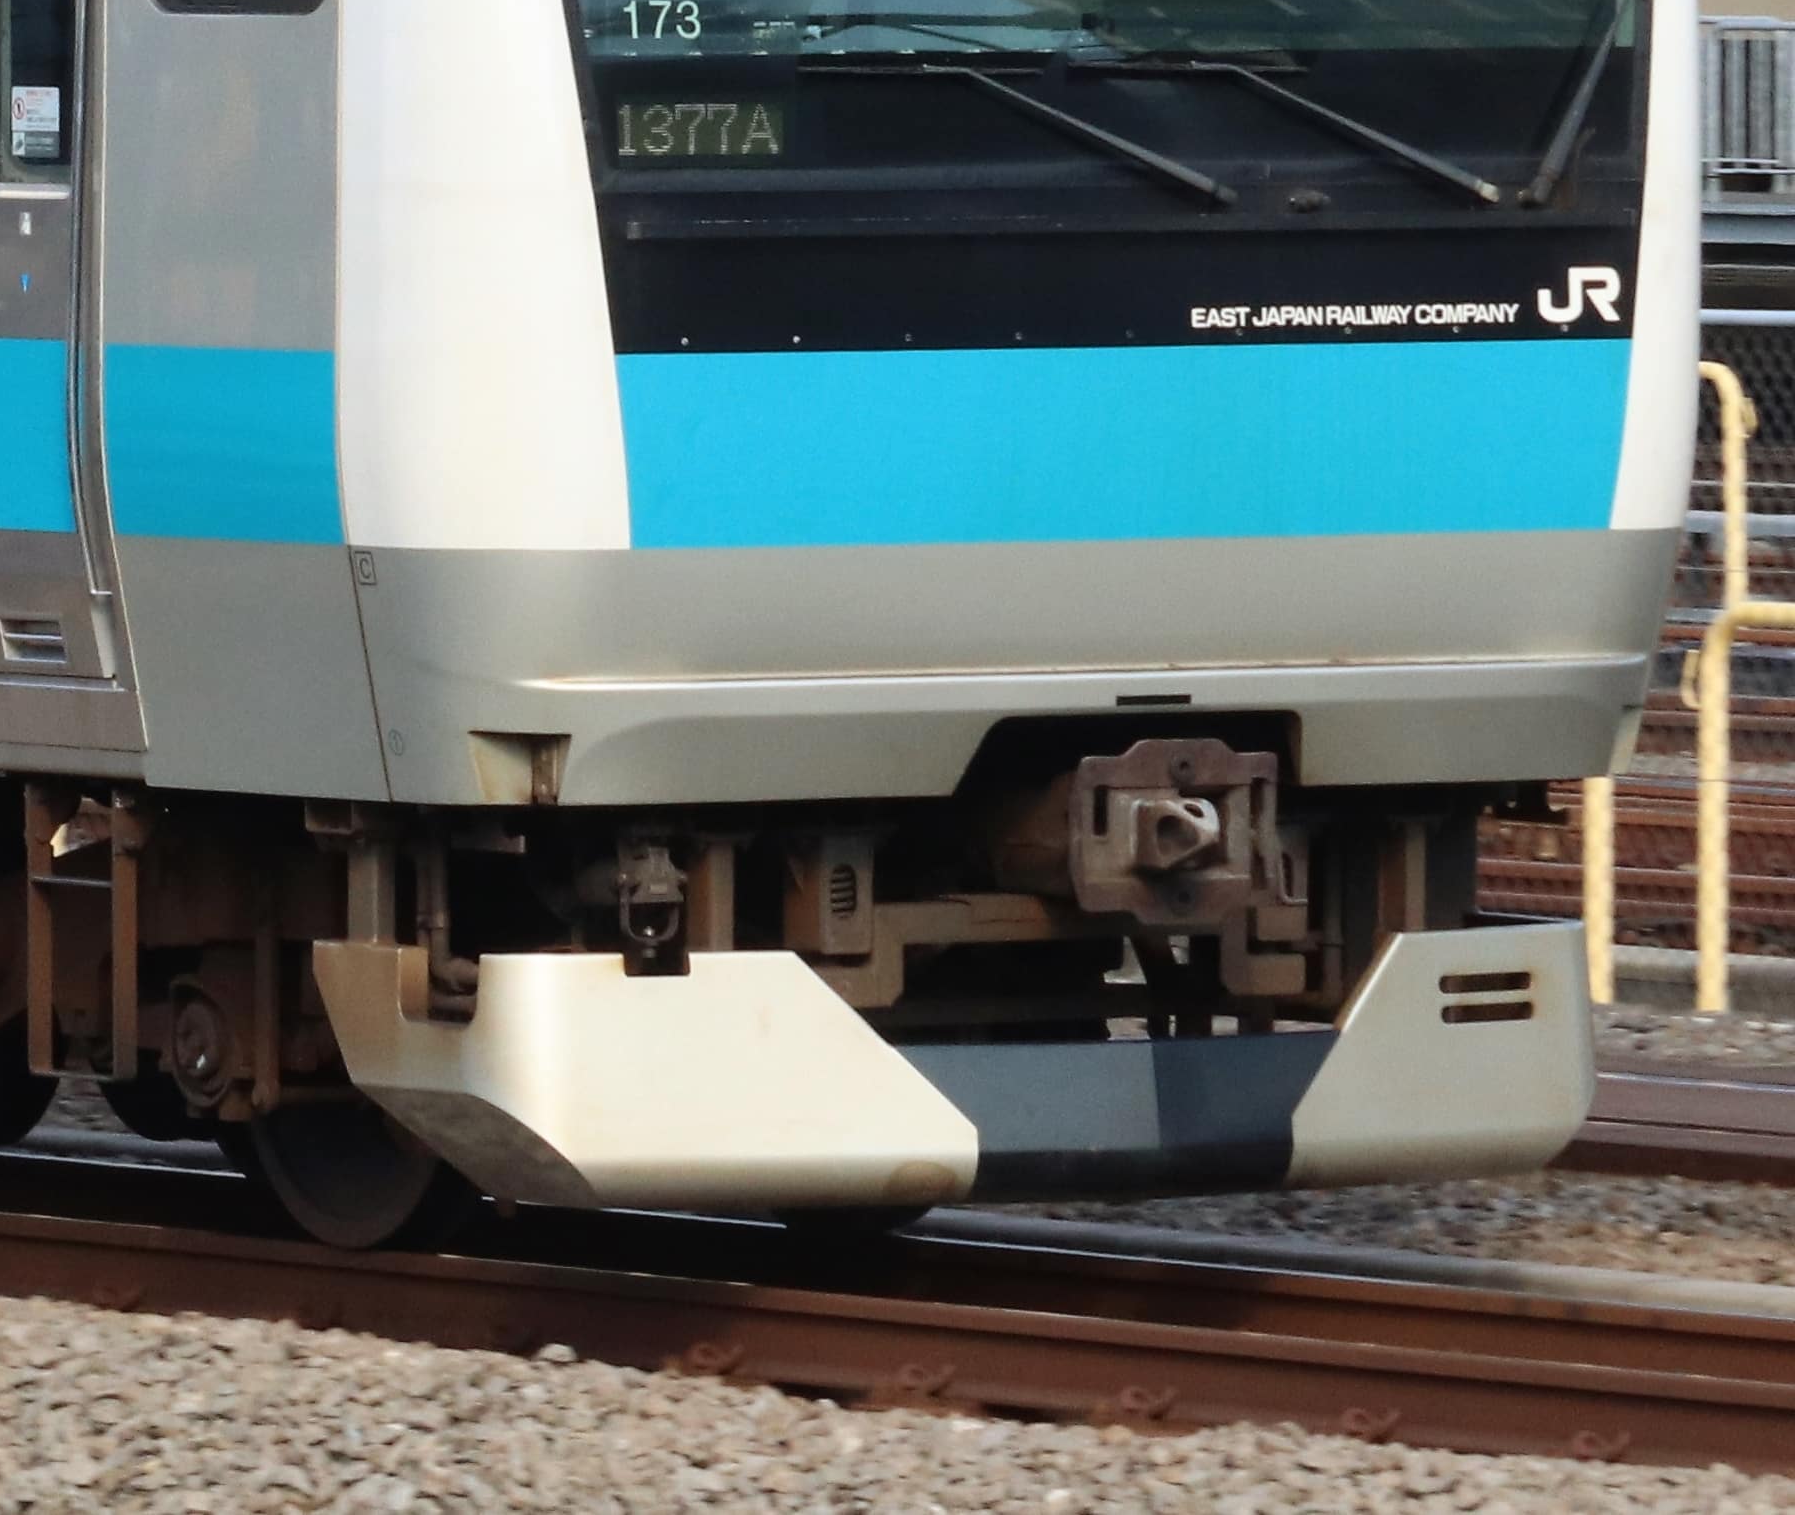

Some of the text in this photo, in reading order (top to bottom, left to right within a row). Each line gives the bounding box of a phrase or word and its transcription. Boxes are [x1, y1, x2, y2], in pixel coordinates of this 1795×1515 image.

[623, 0, 702, 40] 173
[618, 103, 780, 155] 1377A
[1191, 303, 1520, 328] EAST JAPAN RAILWAY COMPANY
[1537, 266, 1621, 323] JR
